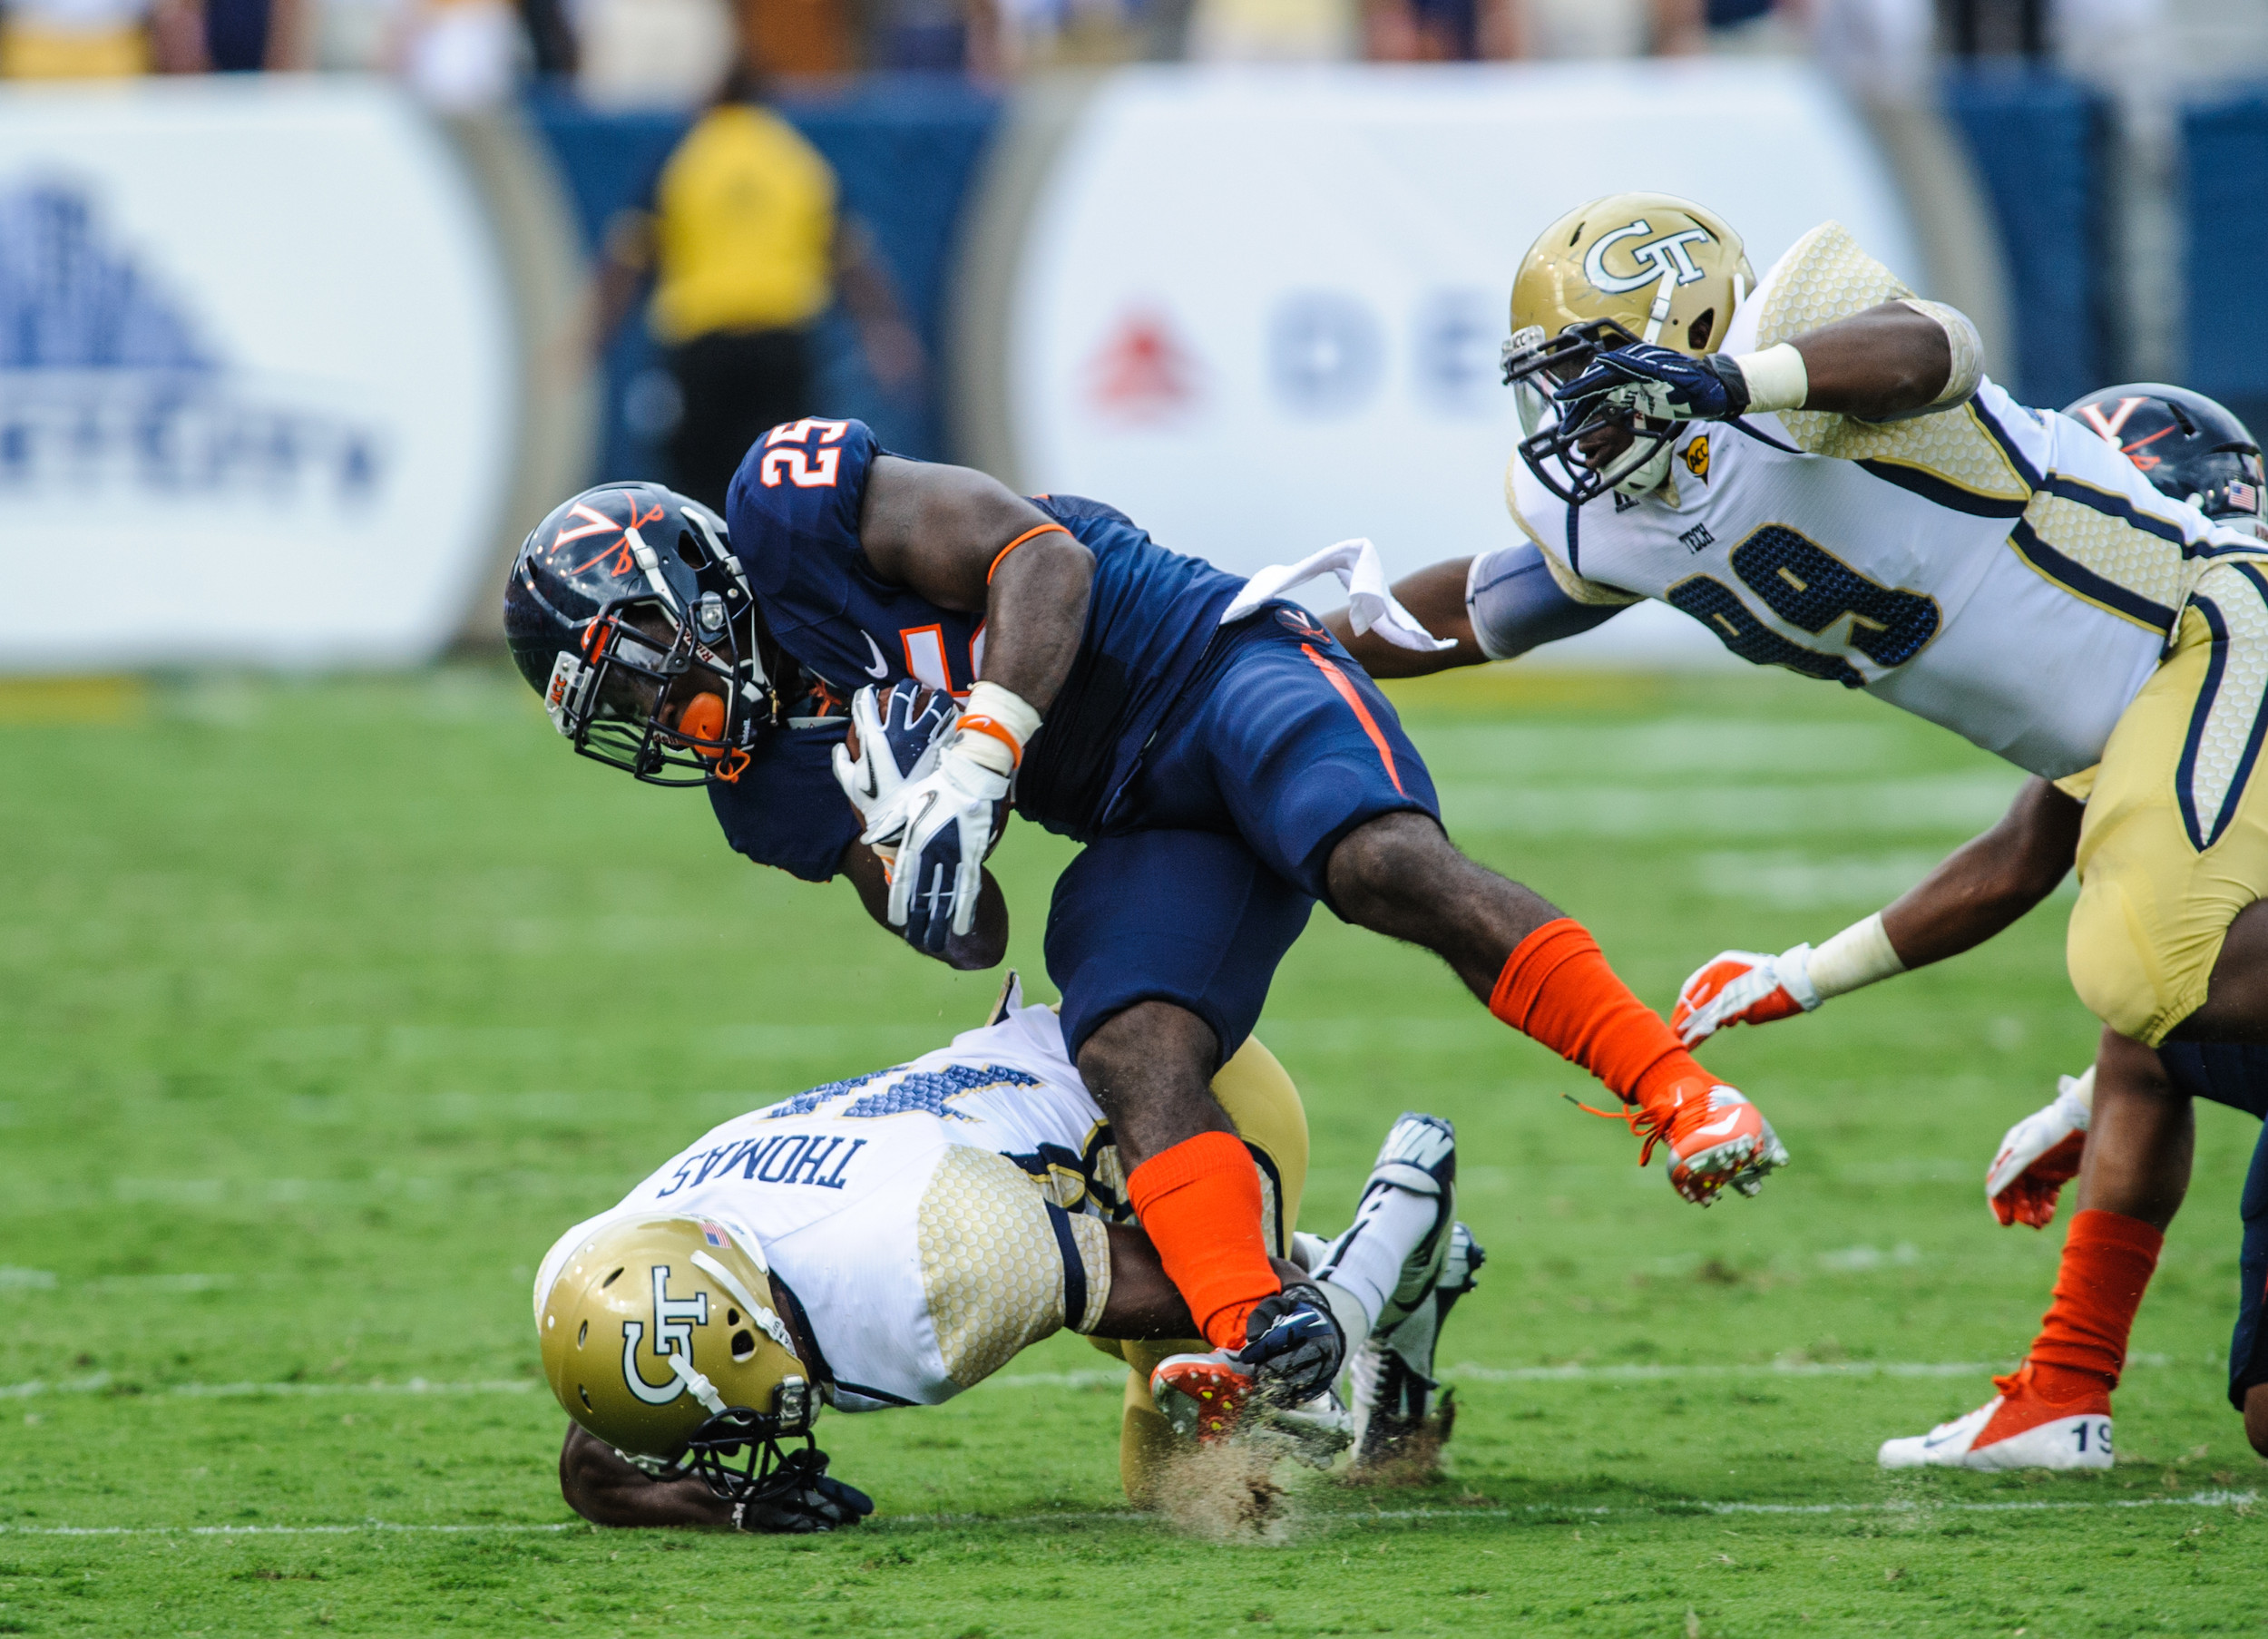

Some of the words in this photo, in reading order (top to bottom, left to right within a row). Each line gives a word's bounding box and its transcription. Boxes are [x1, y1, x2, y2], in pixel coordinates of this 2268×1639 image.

[760, 417, 849, 488] 25
[1688, 443, 1708, 471] ACC
[1678, 522, 1716, 554] TECH
[550, 674, 567, 706] ACC
[655, 1134, 867, 1199] THOMAS
[2071, 1420, 2112, 1454] 19
